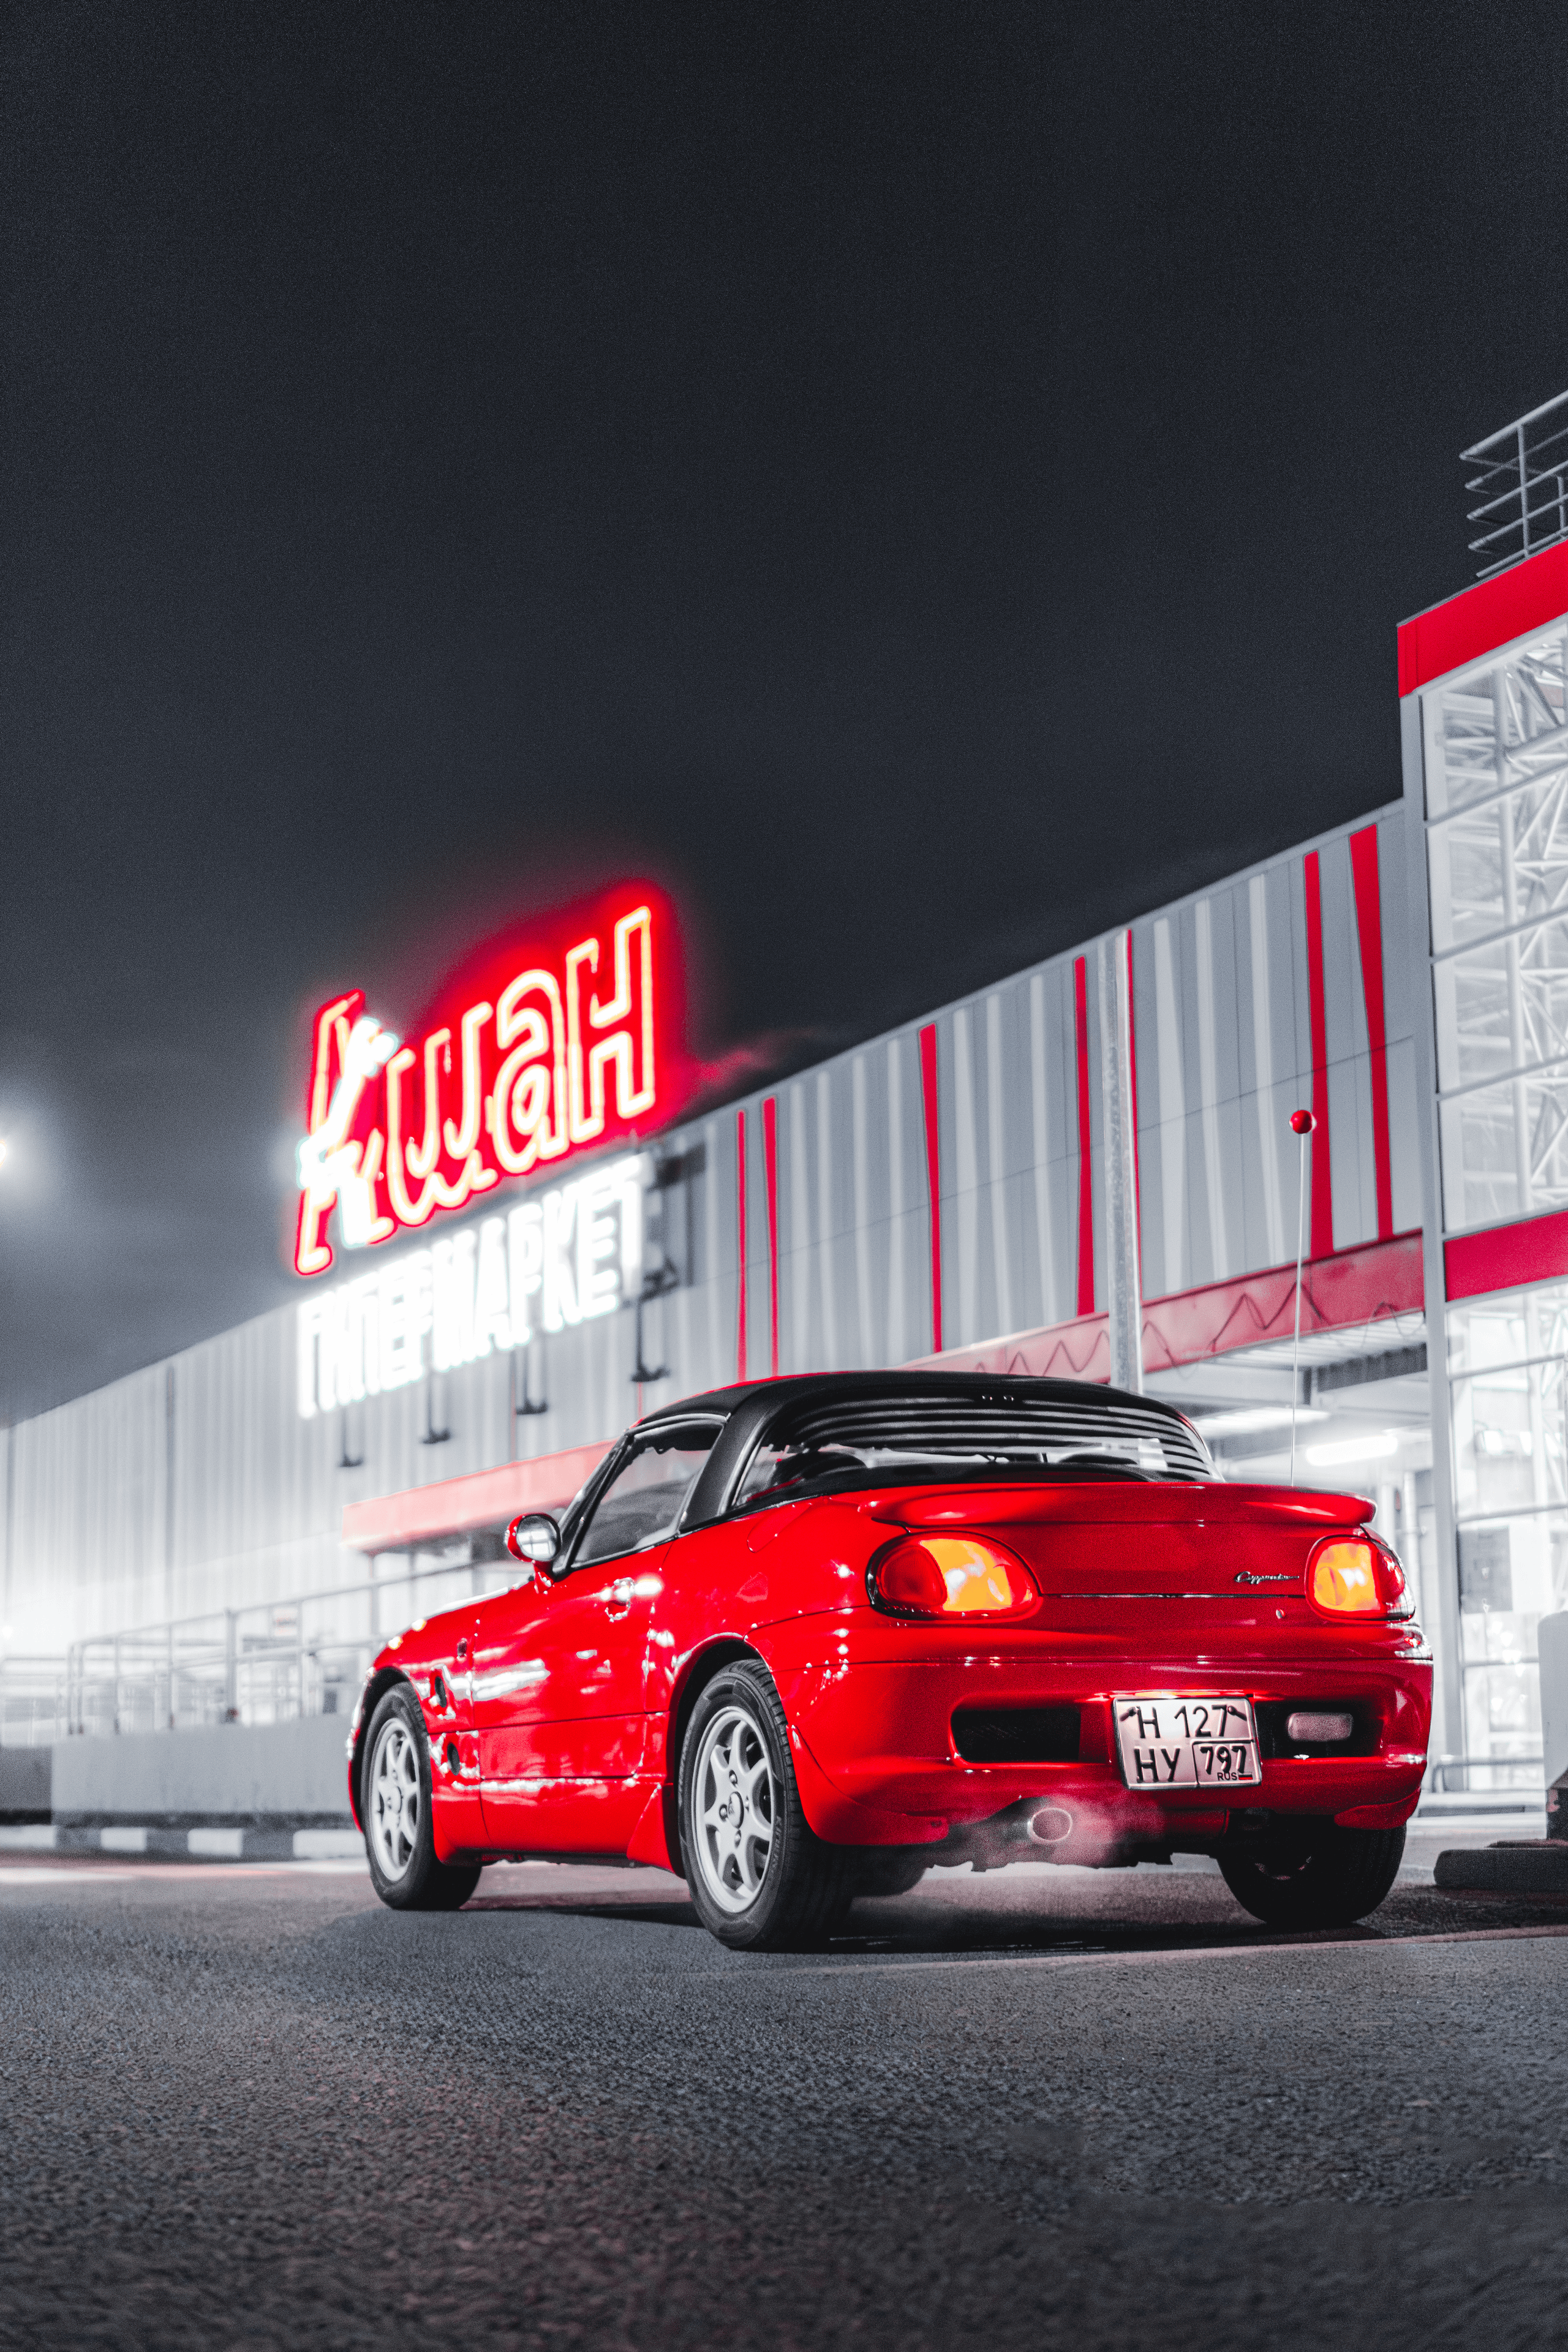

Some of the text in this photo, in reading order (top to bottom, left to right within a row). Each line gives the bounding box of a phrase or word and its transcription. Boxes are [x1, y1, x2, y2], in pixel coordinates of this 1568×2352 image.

[297, 1153, 648, 1419] ГИПЕРМАРКЕТ
[1174, 1705, 1227, 1738] 127
[1200, 1746, 1246, 1774] 797
[1217, 1773, 1238, 1781] RUS
